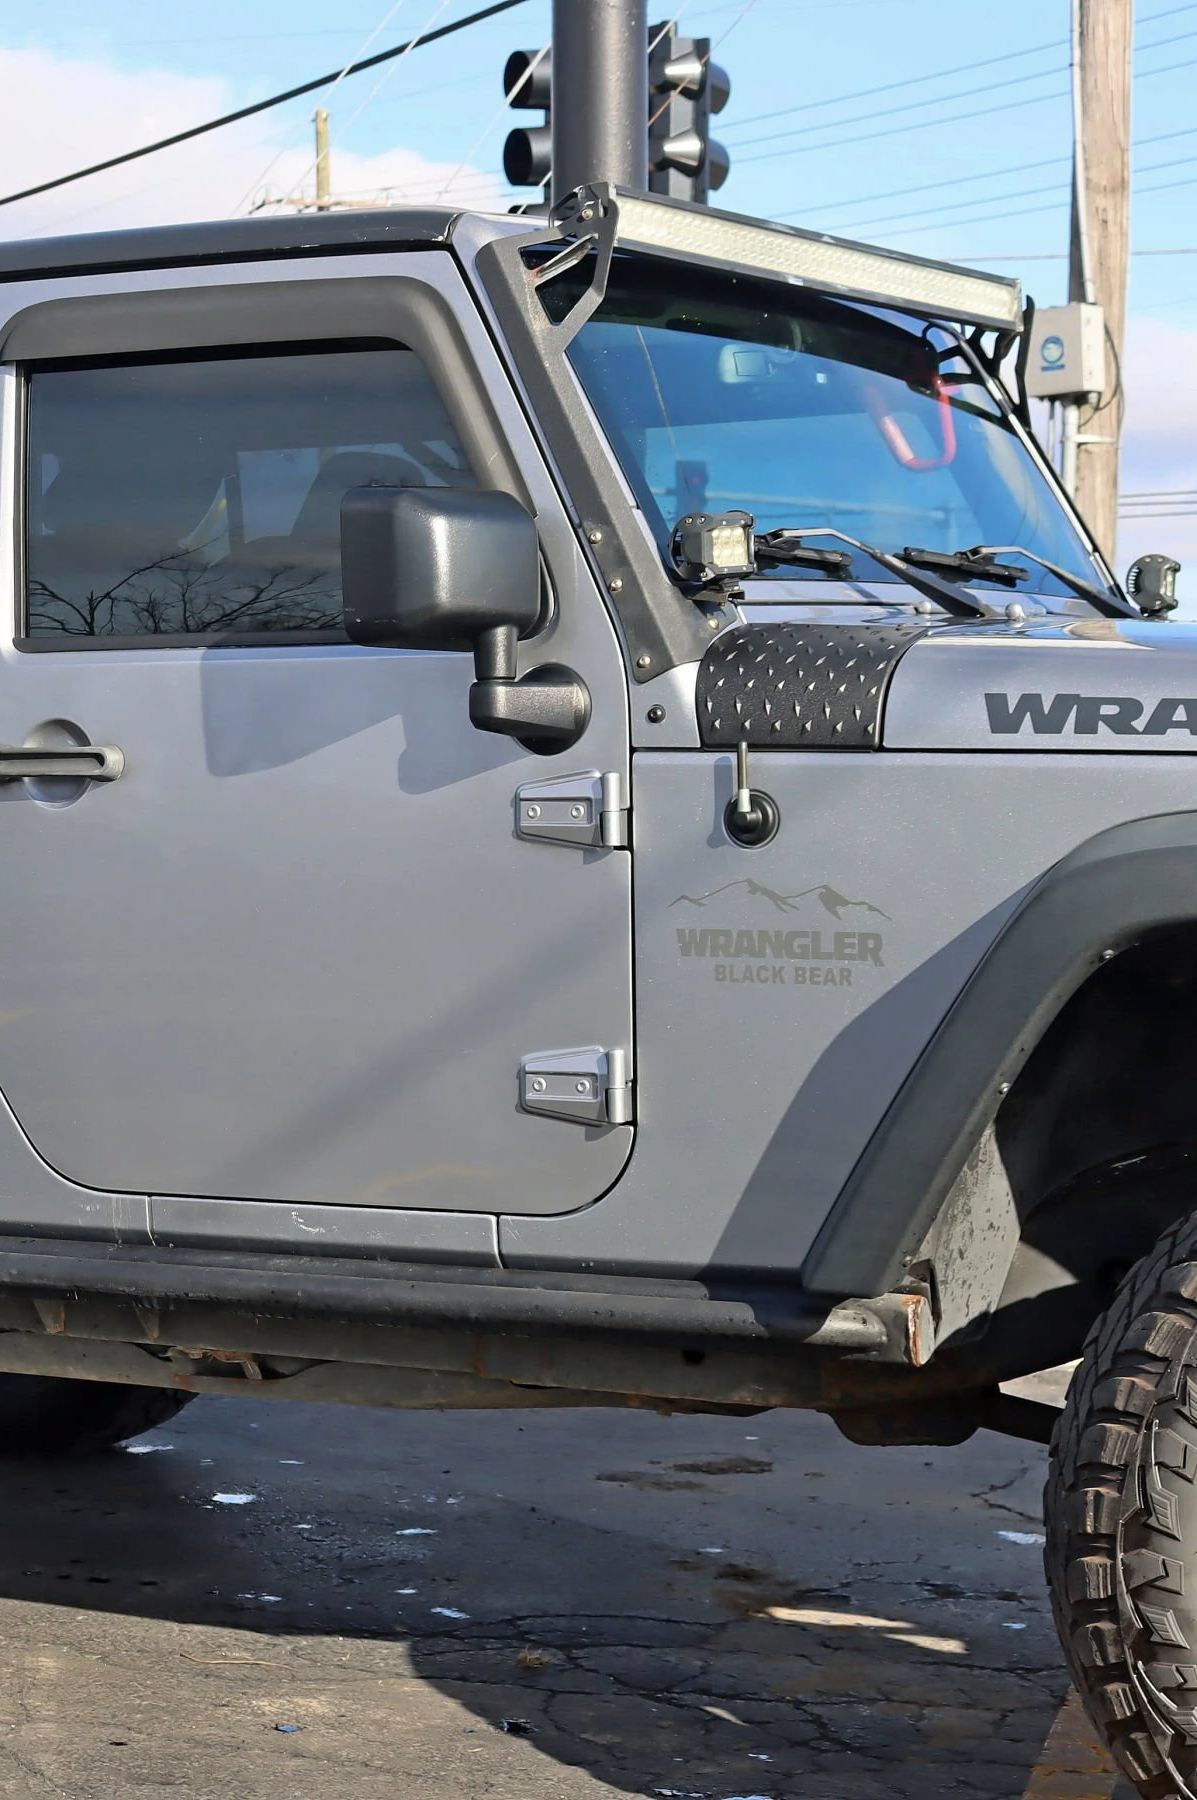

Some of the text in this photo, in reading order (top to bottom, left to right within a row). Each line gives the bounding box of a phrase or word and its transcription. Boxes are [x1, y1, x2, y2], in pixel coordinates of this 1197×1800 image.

[984, 693, 1197, 736] WRA
[676, 928, 885, 966] WRANGLER
[714, 964, 852, 986] BLACK BEAR
